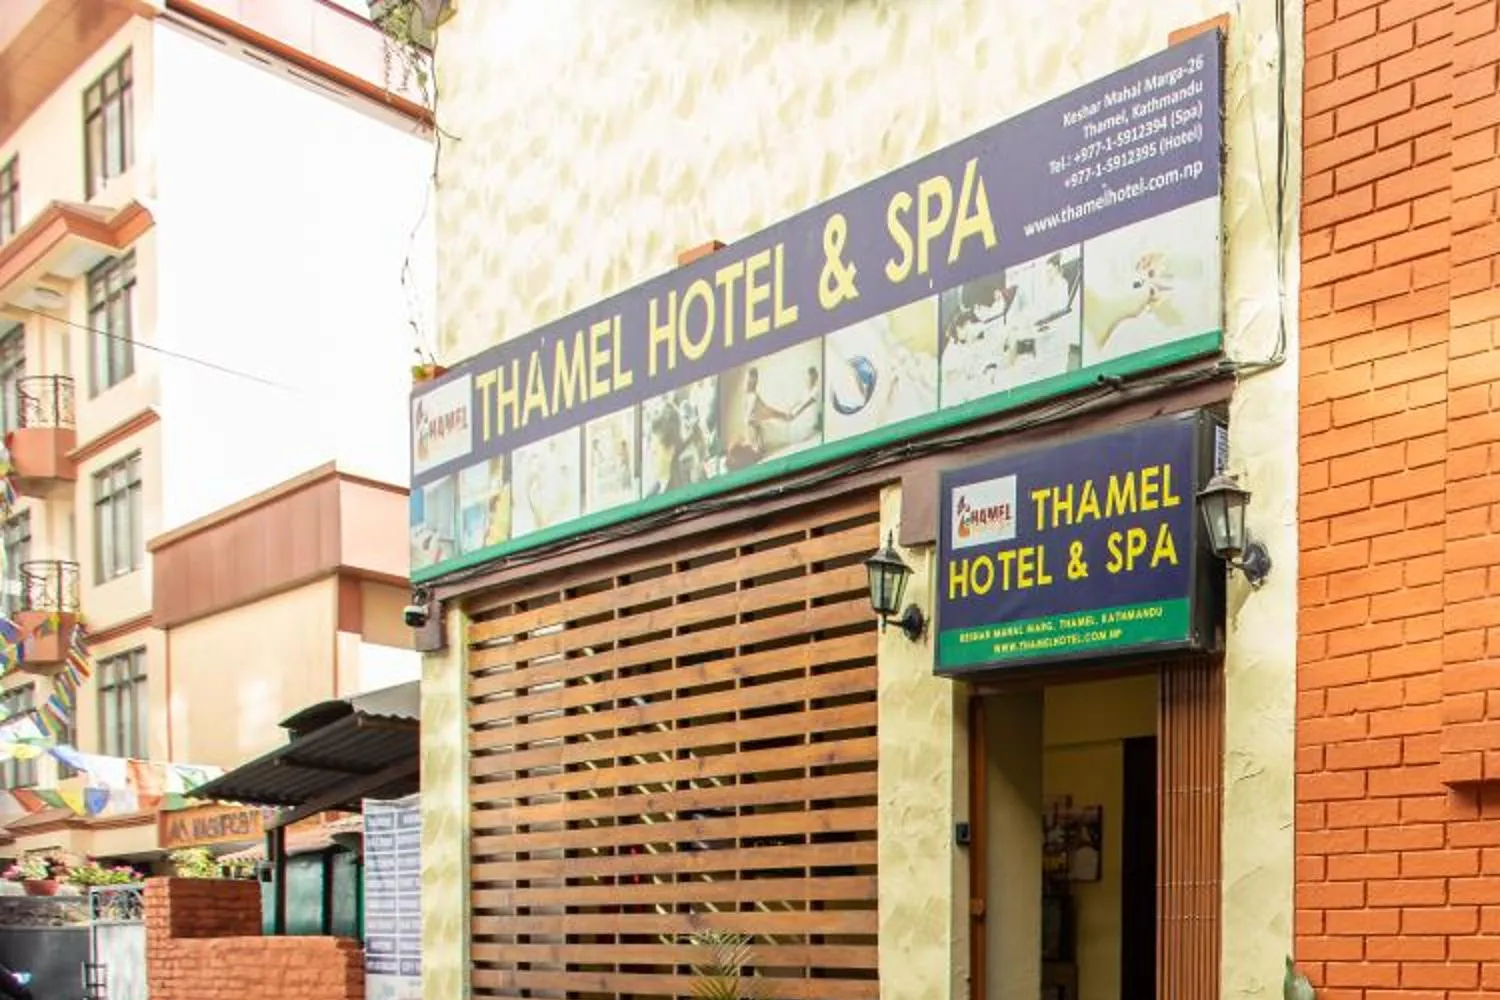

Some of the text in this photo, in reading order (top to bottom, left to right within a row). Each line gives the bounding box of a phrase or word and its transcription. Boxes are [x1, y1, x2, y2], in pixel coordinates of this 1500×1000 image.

[1104, 82, 1142, 106] Mahal
[1144, 54, 1204, 92] Marga-26
[1131, 80, 1203, 118] Kathmandu
[1159, 124, 1203, 155] (Hotel)
[1171, 100, 1203, 128] (Spa)
[1023, 160, 1204, 237] www.thamelhotel.com.np
[476, 157, 998, 442] THAMEL HOTEL & SPA
[1031, 464, 1180, 531] THAMEL
[949, 523, 1178, 600] HOTEL & SPA
